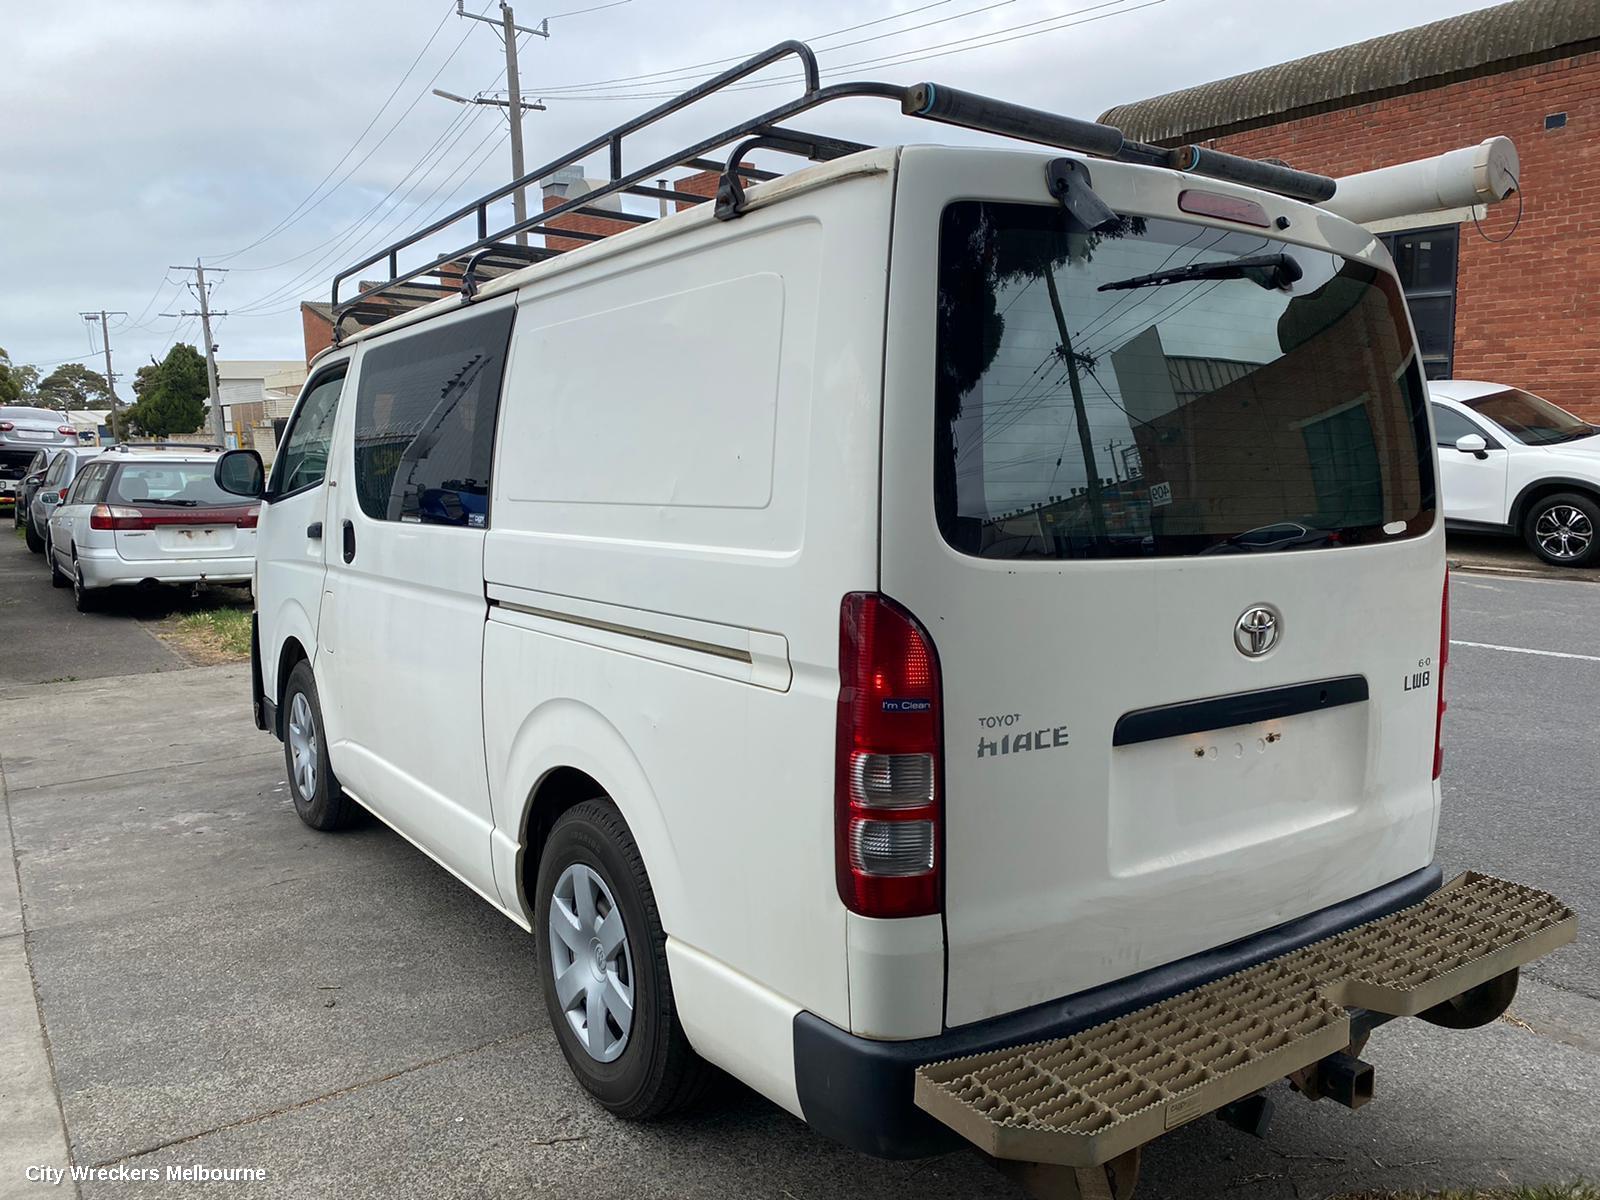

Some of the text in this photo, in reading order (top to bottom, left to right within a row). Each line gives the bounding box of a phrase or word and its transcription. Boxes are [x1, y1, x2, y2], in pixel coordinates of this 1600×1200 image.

[1404, 671, 1430, 691] LWB
[882, 701, 931, 709] I'm Clean
